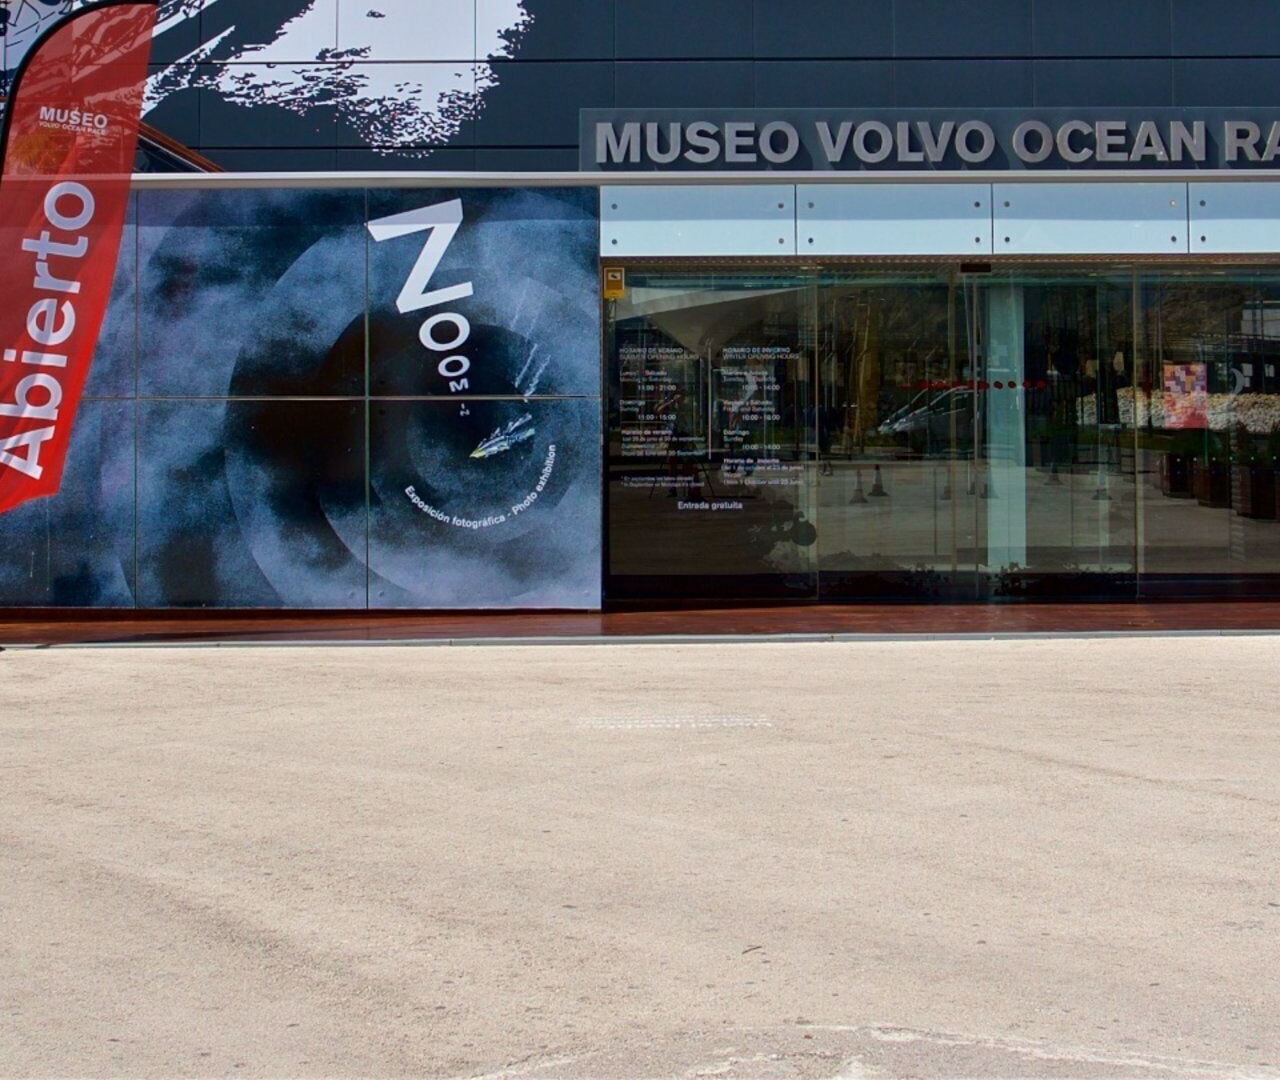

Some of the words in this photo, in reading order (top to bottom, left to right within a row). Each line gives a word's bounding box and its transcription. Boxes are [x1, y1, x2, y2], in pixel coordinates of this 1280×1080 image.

[40, 106, 108, 128] MUSEO
[62, 123, 86, 132] OCEAN
[595, 120, 800, 164] MUSEO
[815, 120, 996, 164] VOLVO
[1012, 119, 1206, 163] OCEAN
[404, 485, 450, 524] Exposición
[452, 514, 506, 529] fotográfica
[511, 490, 538, 516] Photo
[536, 444, 556, 492] exhibition
[678, 501, 710, 510] Entrada
[711, 501, 743, 510] gratuita
